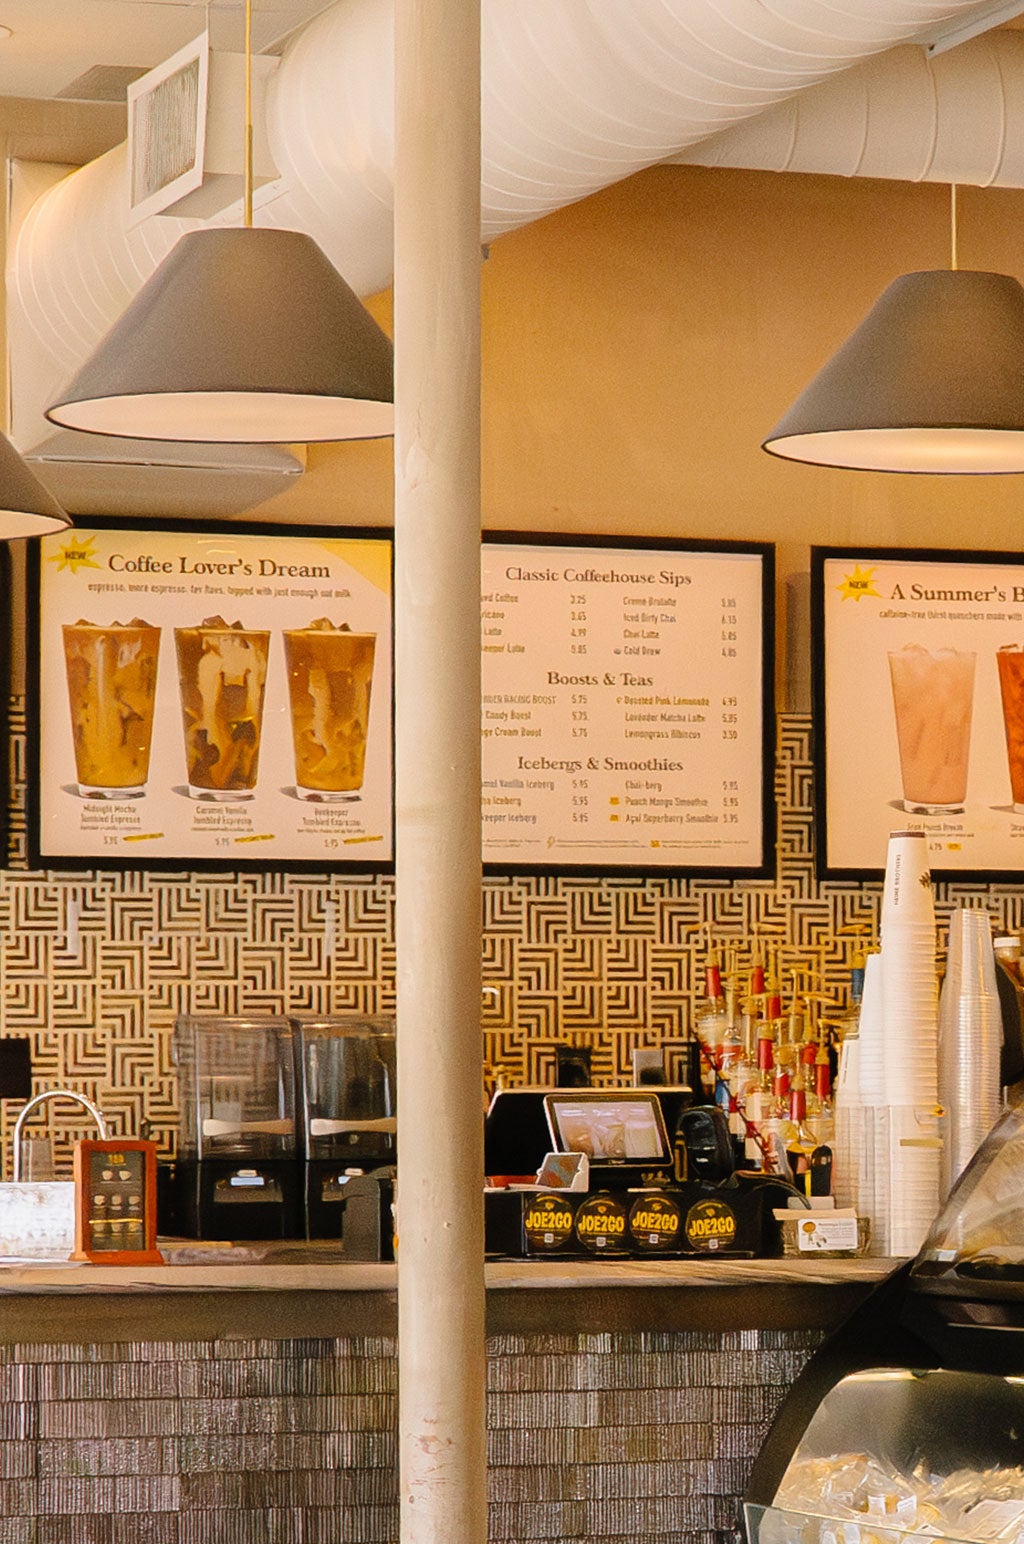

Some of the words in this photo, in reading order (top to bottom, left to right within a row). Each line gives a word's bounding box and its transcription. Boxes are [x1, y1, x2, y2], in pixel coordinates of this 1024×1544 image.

[65, 551, 87, 560] NEW
[109, 554, 173, 573] Coffee
[179, 556, 253, 575] Lover's
[259, 559, 331, 578] Dream
[505, 567, 559, 581] Classic
[563, 569, 655, 583] Coffeehouse
[658, 571, 692, 587] Sips
[849, 580, 869, 590] NEW
[890, 583, 906, 600] A
[910, 583, 1007, 603] Summer's
[482, 611, 505, 619] ricano
[547, 671, 600, 686] Boosts
[603, 672, 618, 686] &
[620, 672, 655, 687] Teas
[532, 695, 557, 705] BOOST
[518, 756, 583, 774] Icebergs
[586, 756, 602, 771] &
[603, 757, 685, 772] Smoothies
[526, 780, 555, 792] Iceberg
[525, 1212, 572, 1229] JOE2GO
[579, 1214, 625, 1233] JOE2GO
[632, 1211, 678, 1229] JOE2GO
[689, 1216, 736, 1236] JOE2GO
